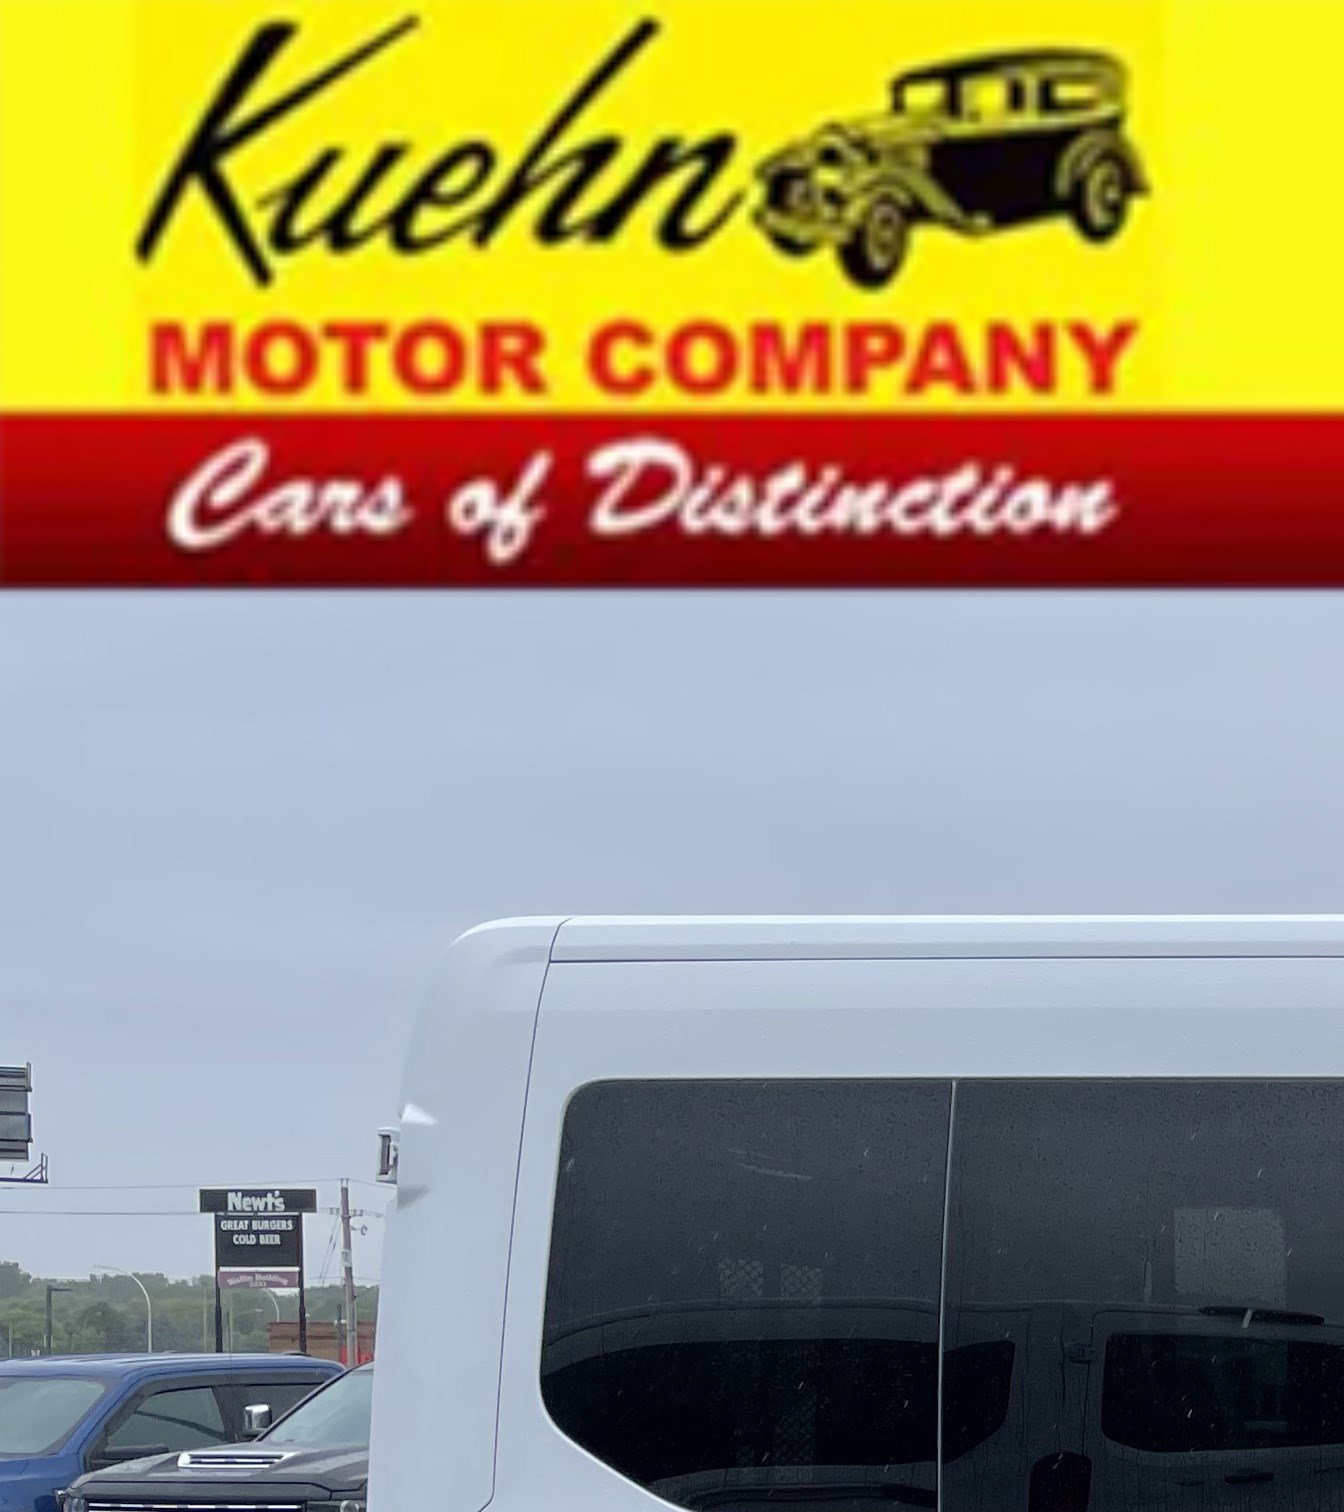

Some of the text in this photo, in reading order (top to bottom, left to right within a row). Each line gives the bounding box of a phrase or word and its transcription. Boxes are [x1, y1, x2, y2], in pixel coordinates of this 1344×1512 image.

[226, 1190, 286, 1212] Newt's
[220, 1220, 294, 1231] GREAT BURGERS
[232, 1234, 281, 1245] COLD BEER
